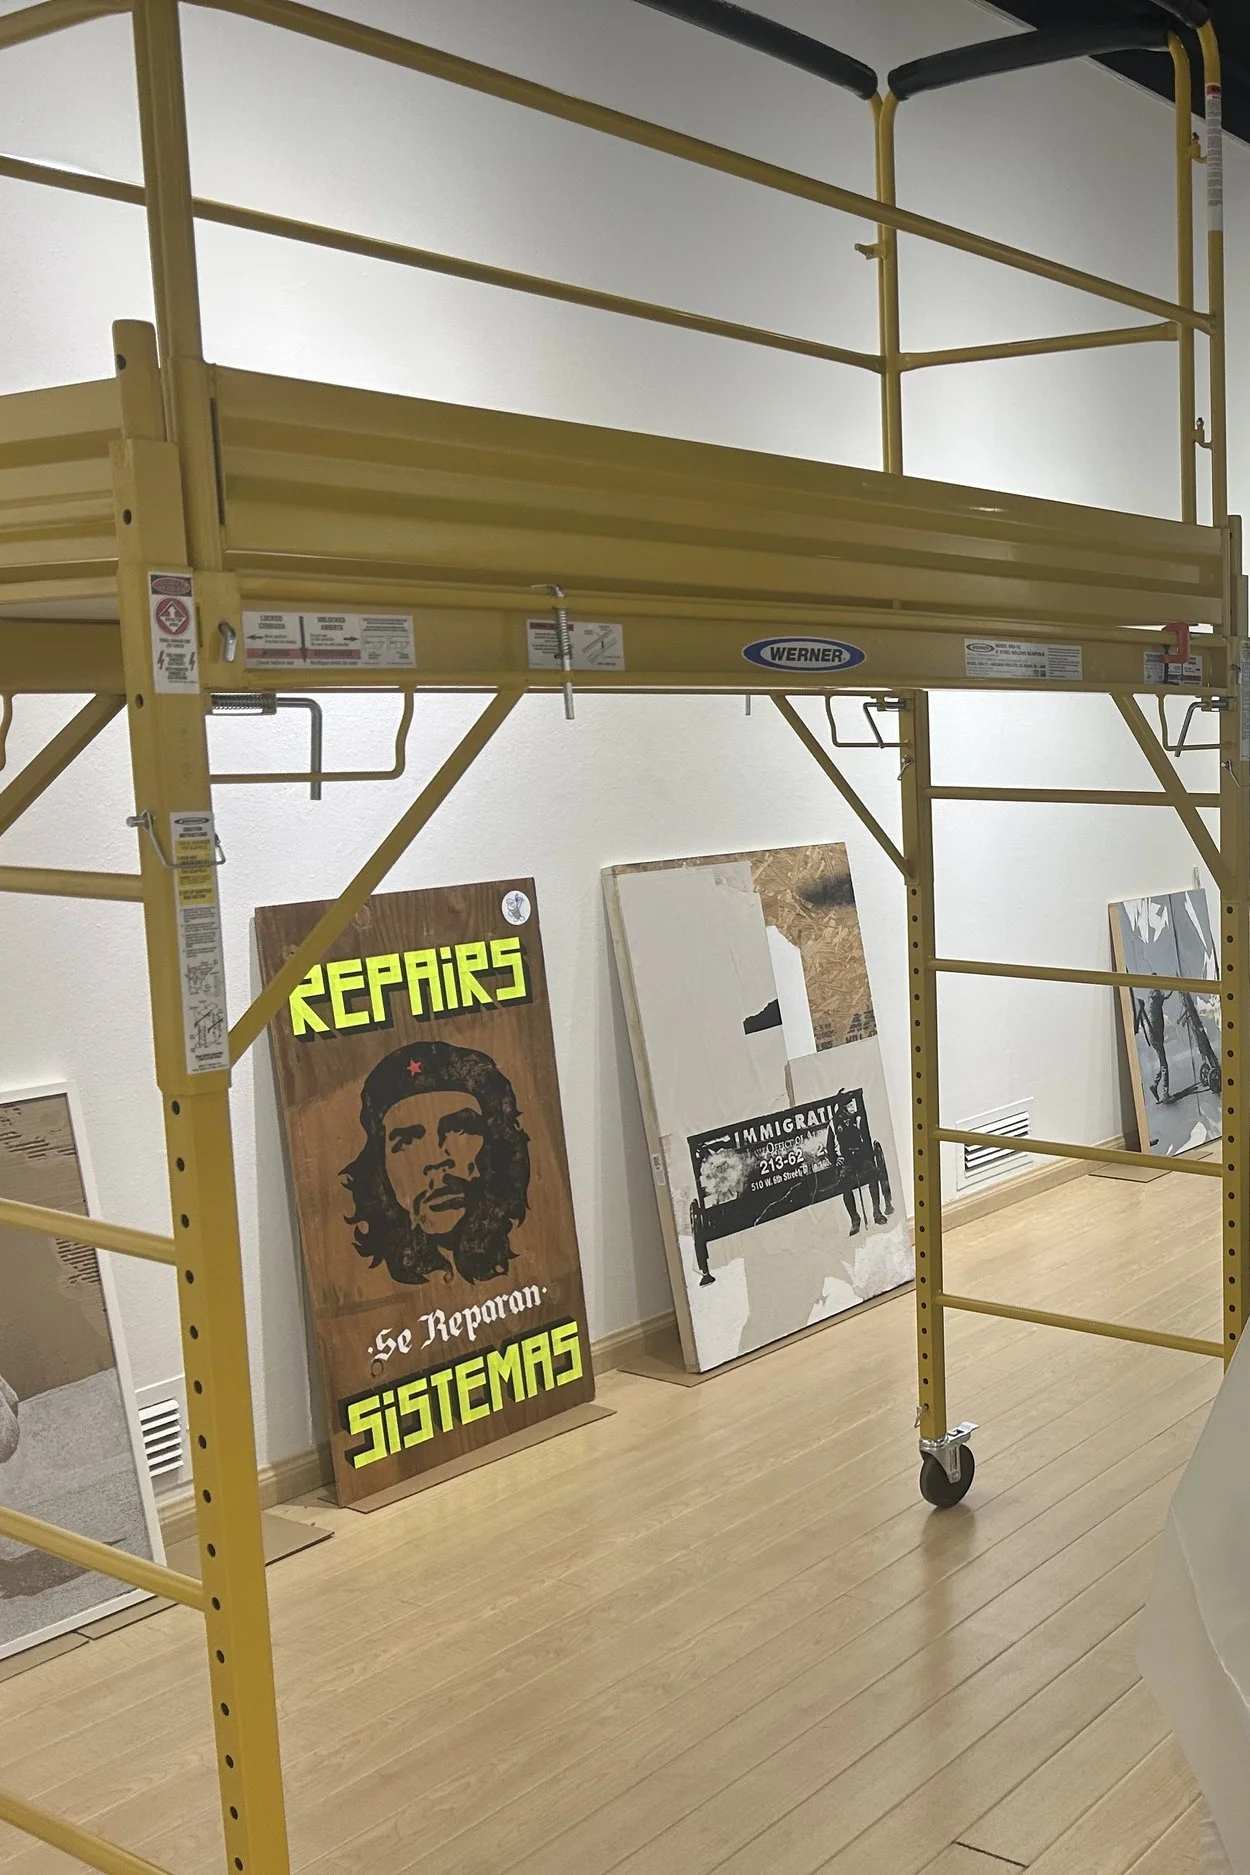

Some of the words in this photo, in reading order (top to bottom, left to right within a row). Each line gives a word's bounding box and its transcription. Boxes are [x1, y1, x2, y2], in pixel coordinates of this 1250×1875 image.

[770, 646, 843, 662] WERNER
[751, 1179, 764, 1192] 510
[417, 1284, 542, 1350] Reparan
